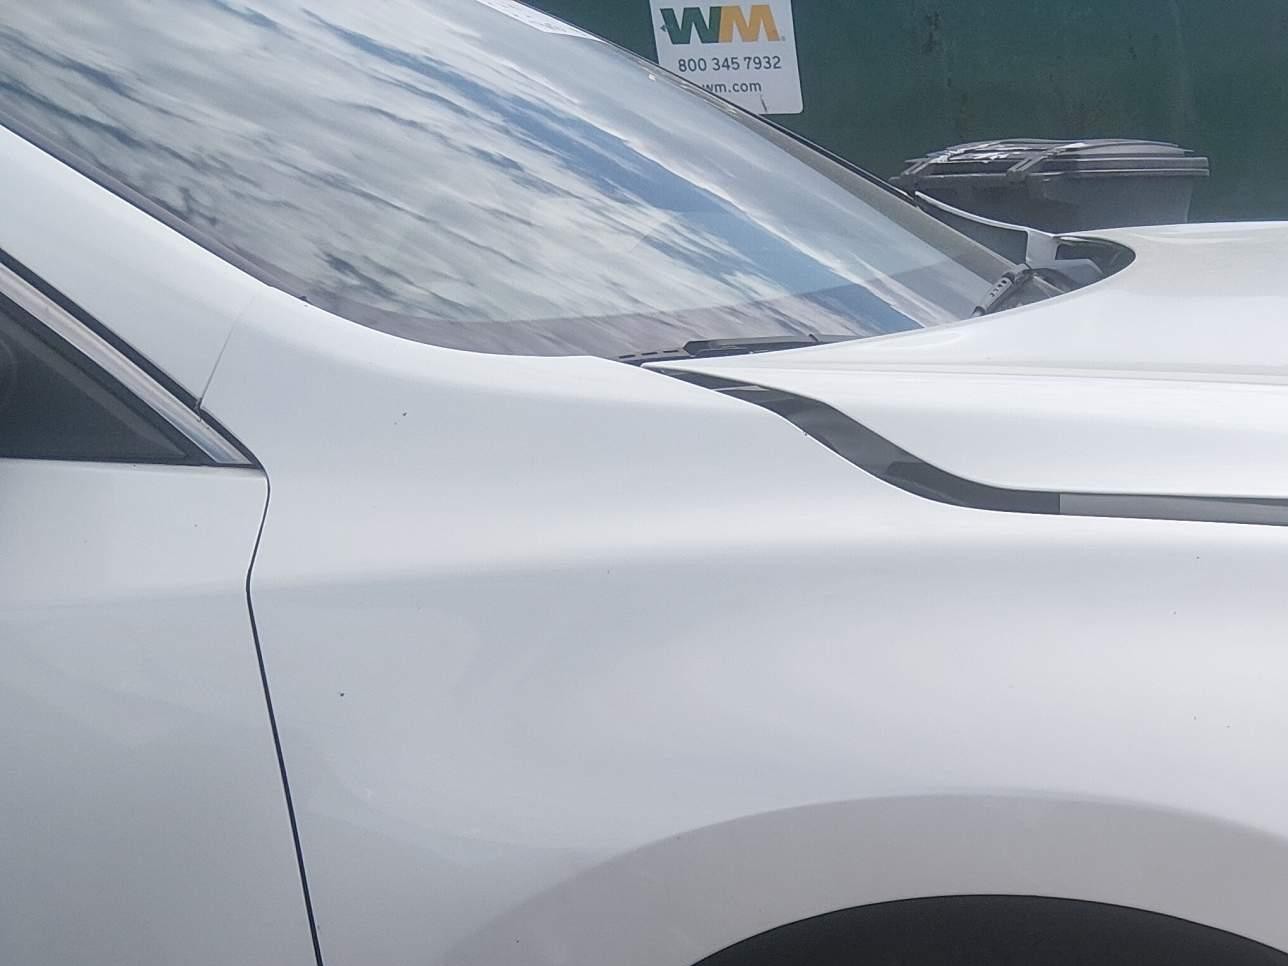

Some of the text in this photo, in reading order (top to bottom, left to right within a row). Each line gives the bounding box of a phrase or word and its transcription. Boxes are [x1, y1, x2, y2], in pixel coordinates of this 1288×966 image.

[660, 4, 780, 45] WM
[678, 55, 782, 72] 800 345 7932
